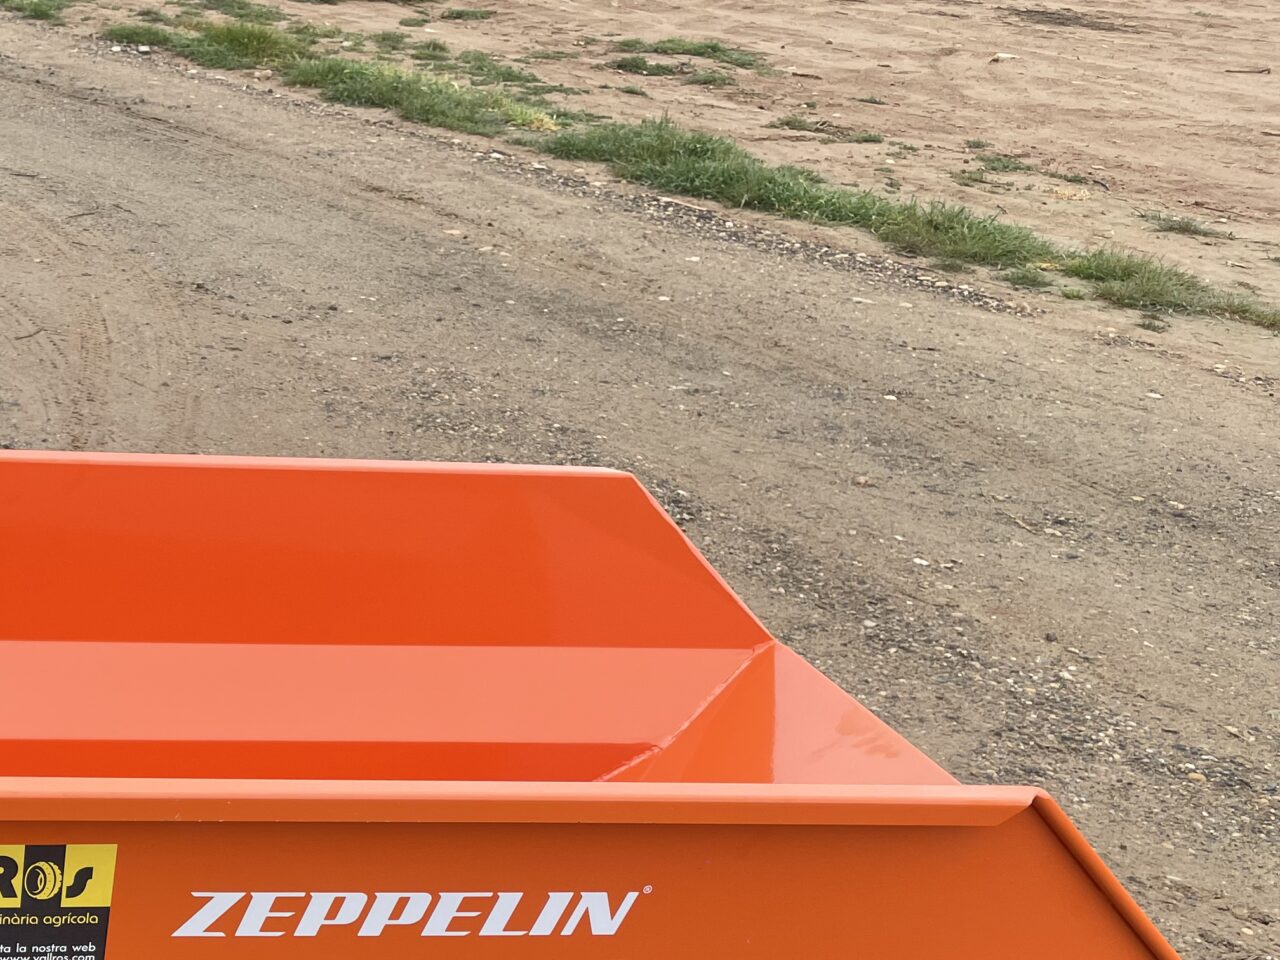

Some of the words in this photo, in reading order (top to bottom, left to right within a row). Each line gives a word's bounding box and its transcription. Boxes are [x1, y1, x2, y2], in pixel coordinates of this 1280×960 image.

[43, 912, 99, 928] agrícola
[16, 943, 27, 953] la
[32, 943, 67, 953] nostra
[72, 941, 96, 952] web
